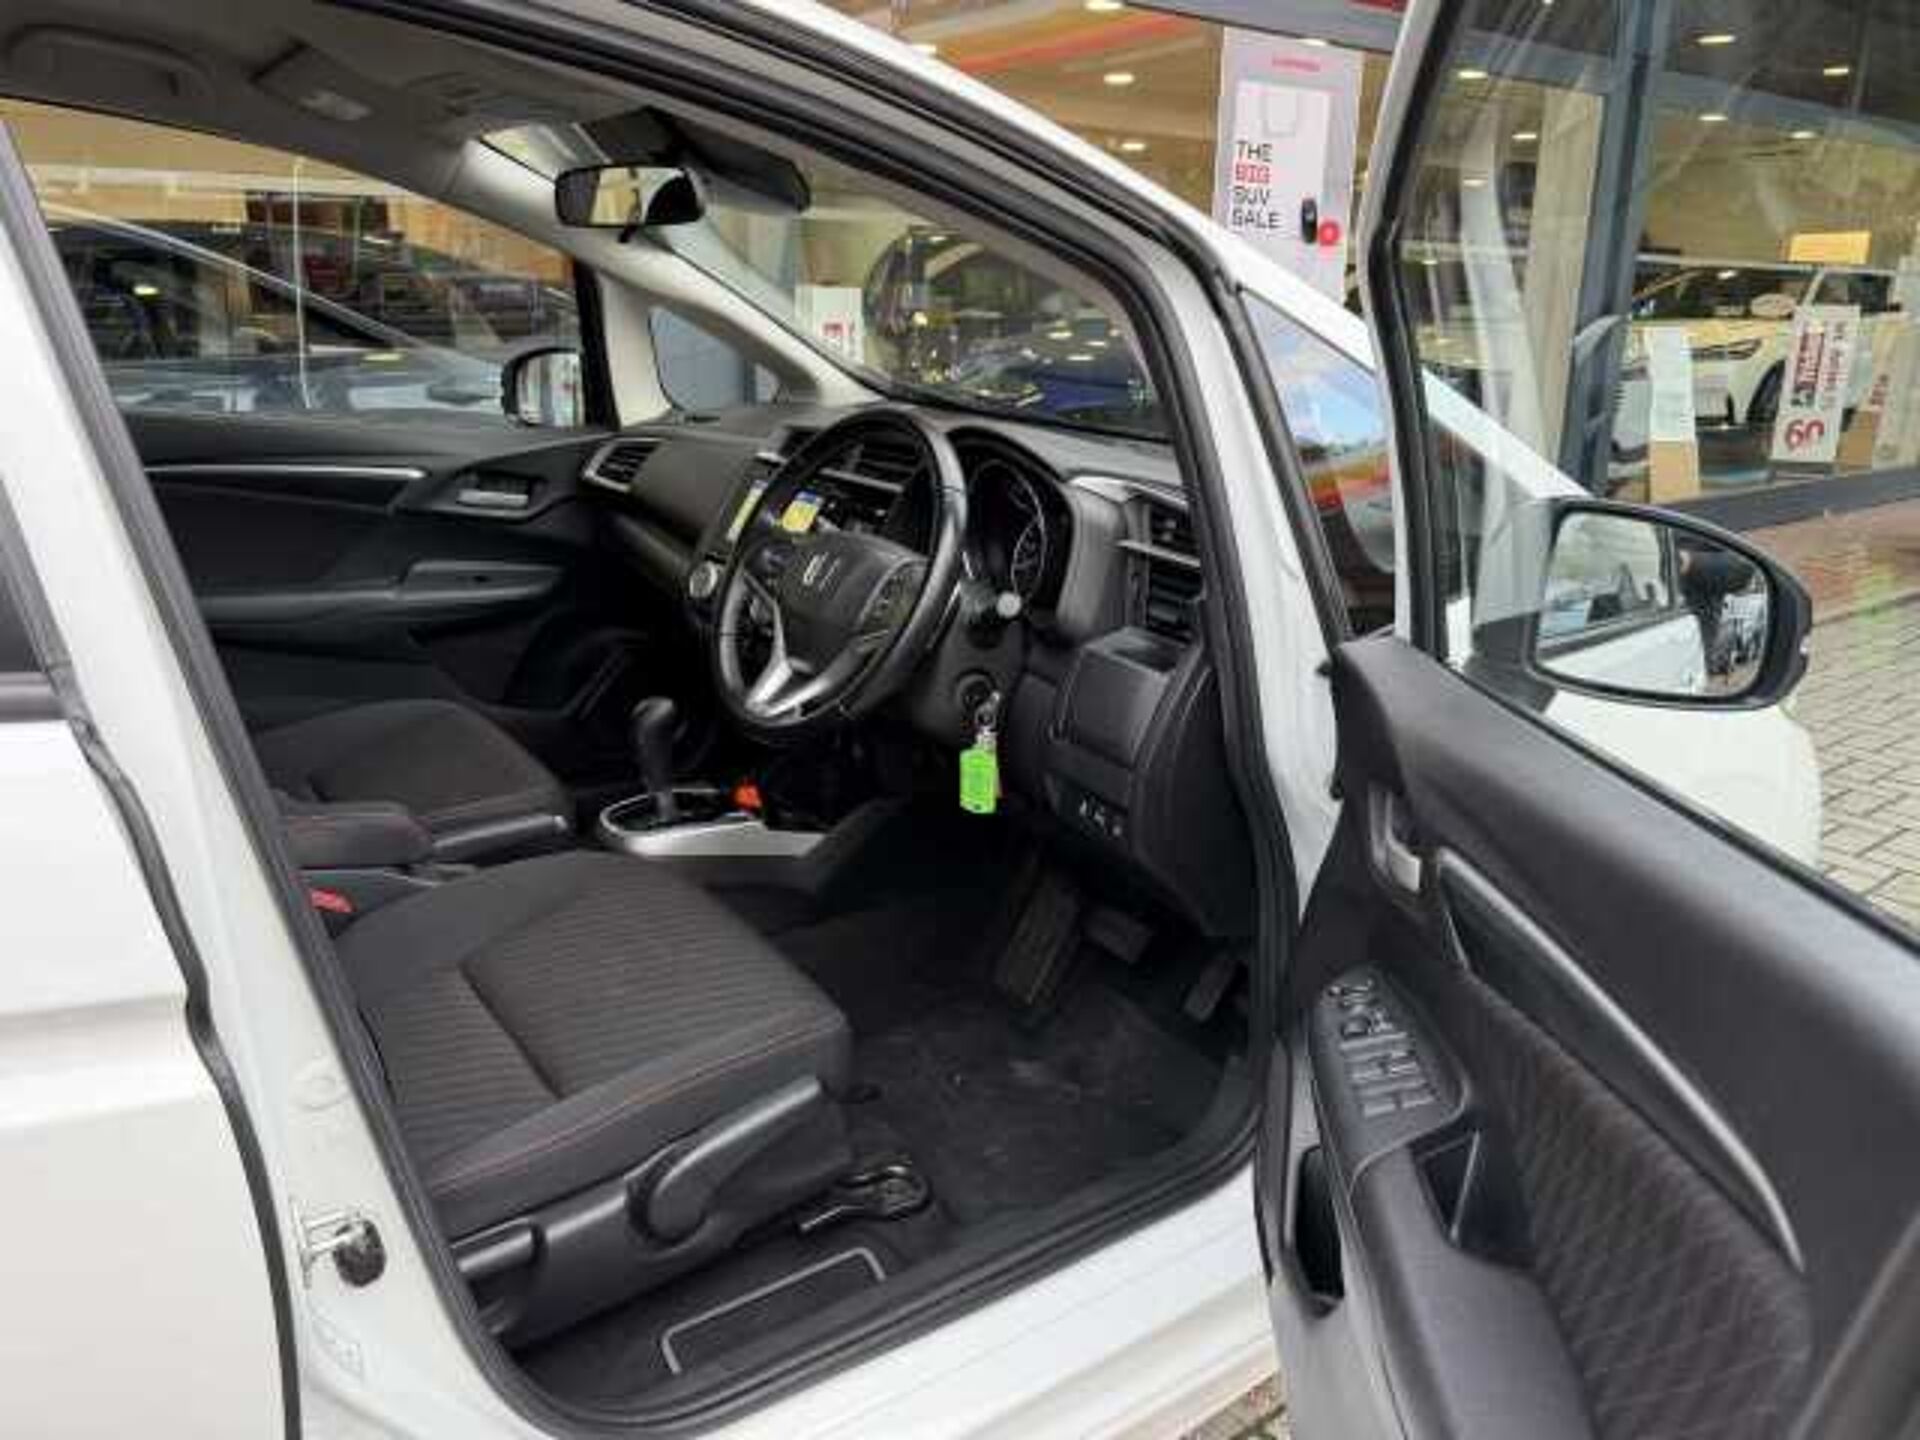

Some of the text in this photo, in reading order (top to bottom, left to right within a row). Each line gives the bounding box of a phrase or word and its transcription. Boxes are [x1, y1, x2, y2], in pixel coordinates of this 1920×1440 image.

[1236, 140, 1273, 162] THE
[1235, 163, 1271, 184] BIG
[1231, 208, 1281, 229] SALE
